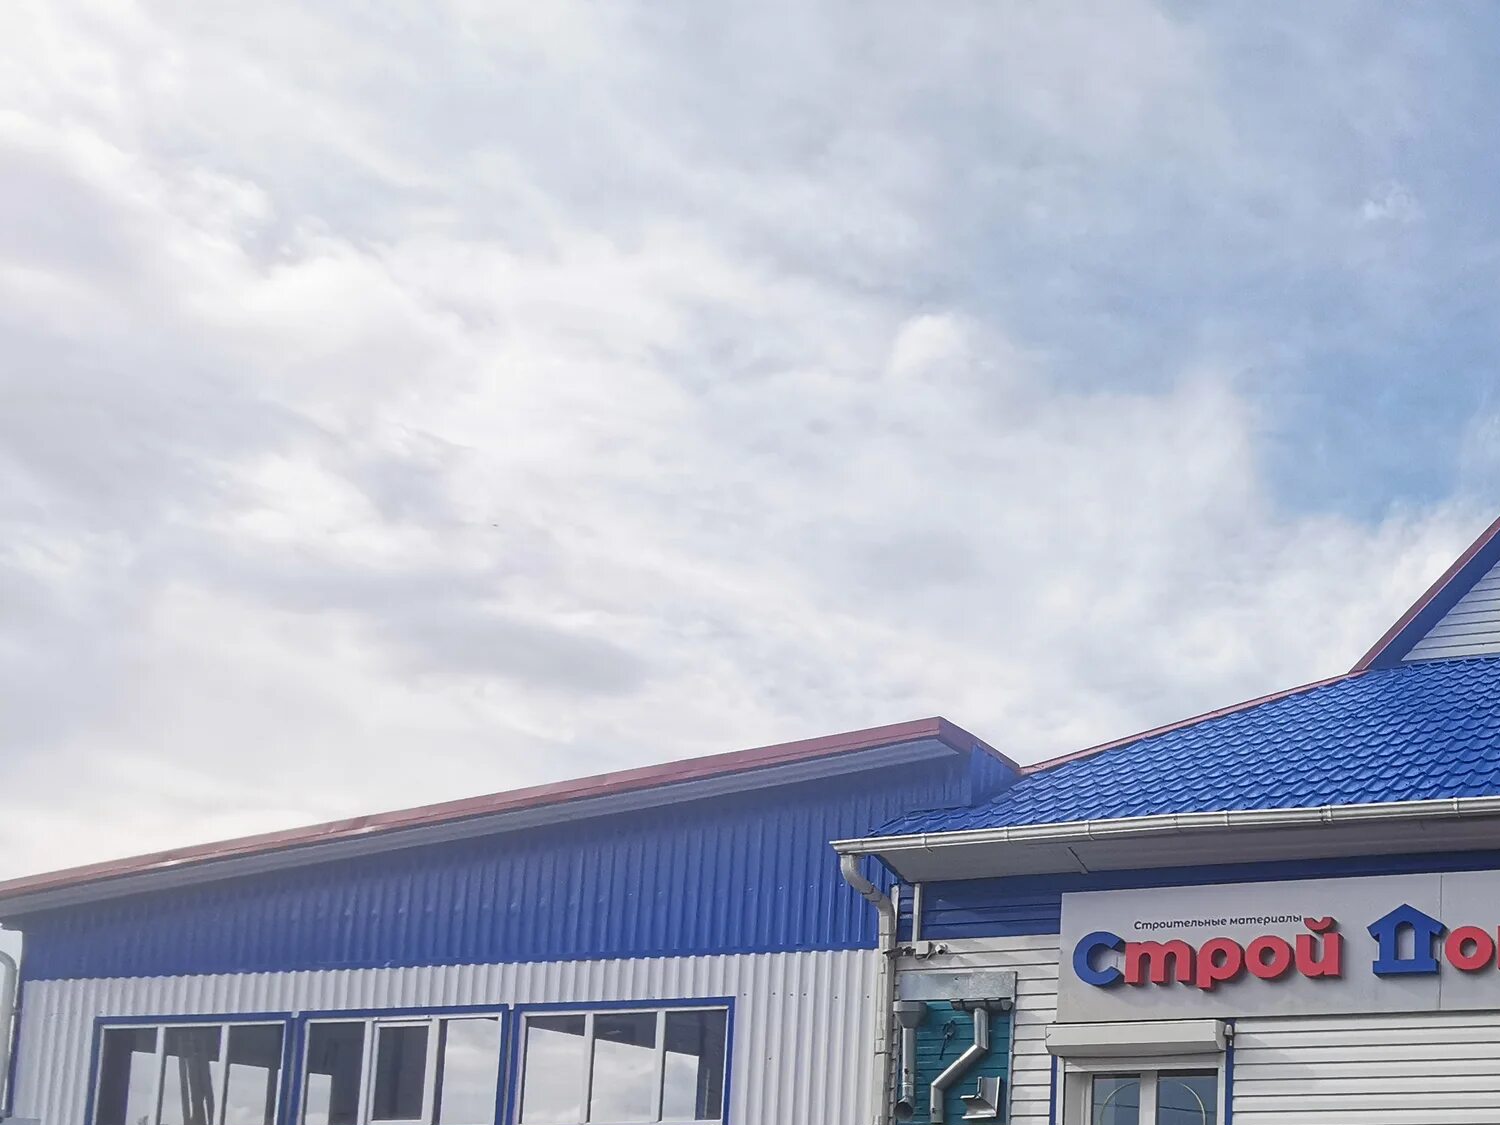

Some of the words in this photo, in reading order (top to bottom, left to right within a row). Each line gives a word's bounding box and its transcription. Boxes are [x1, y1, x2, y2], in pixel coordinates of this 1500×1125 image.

[1134, 917, 1227, 931] Строительные
[1230, 914, 1302, 926] материалы
[1072, 916, 1344, 990] Строй
